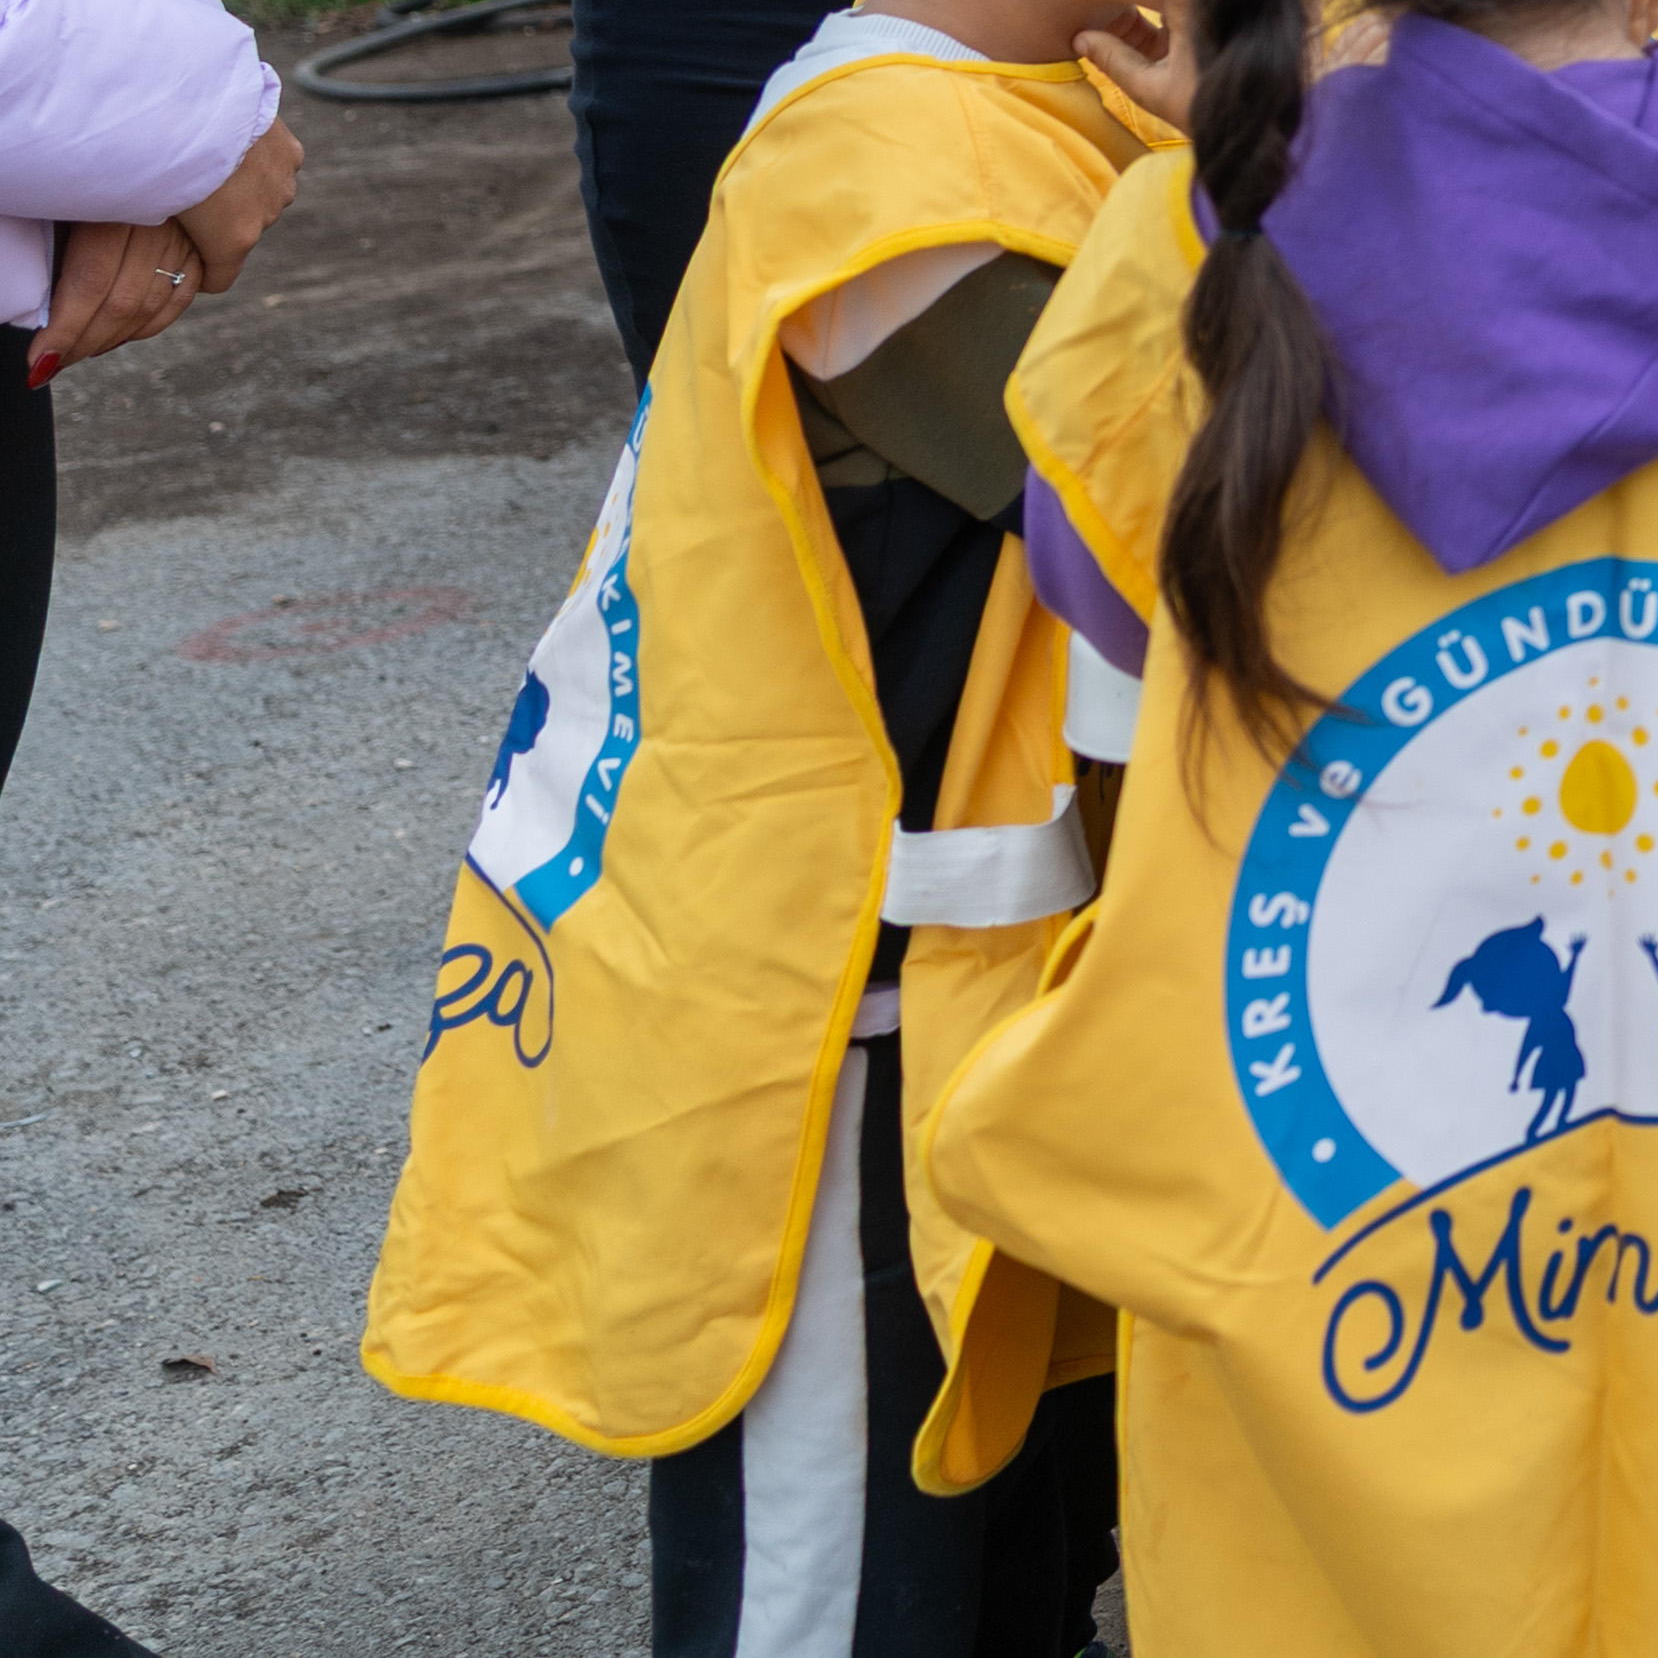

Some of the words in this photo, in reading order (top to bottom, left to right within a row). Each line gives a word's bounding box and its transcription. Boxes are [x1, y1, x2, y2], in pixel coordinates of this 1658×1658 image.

[585, 570, 634, 825] KIMEVİ
[1242, 890, 1311, 1097] KREŞ
[1289, 760, 1362, 838] ve
